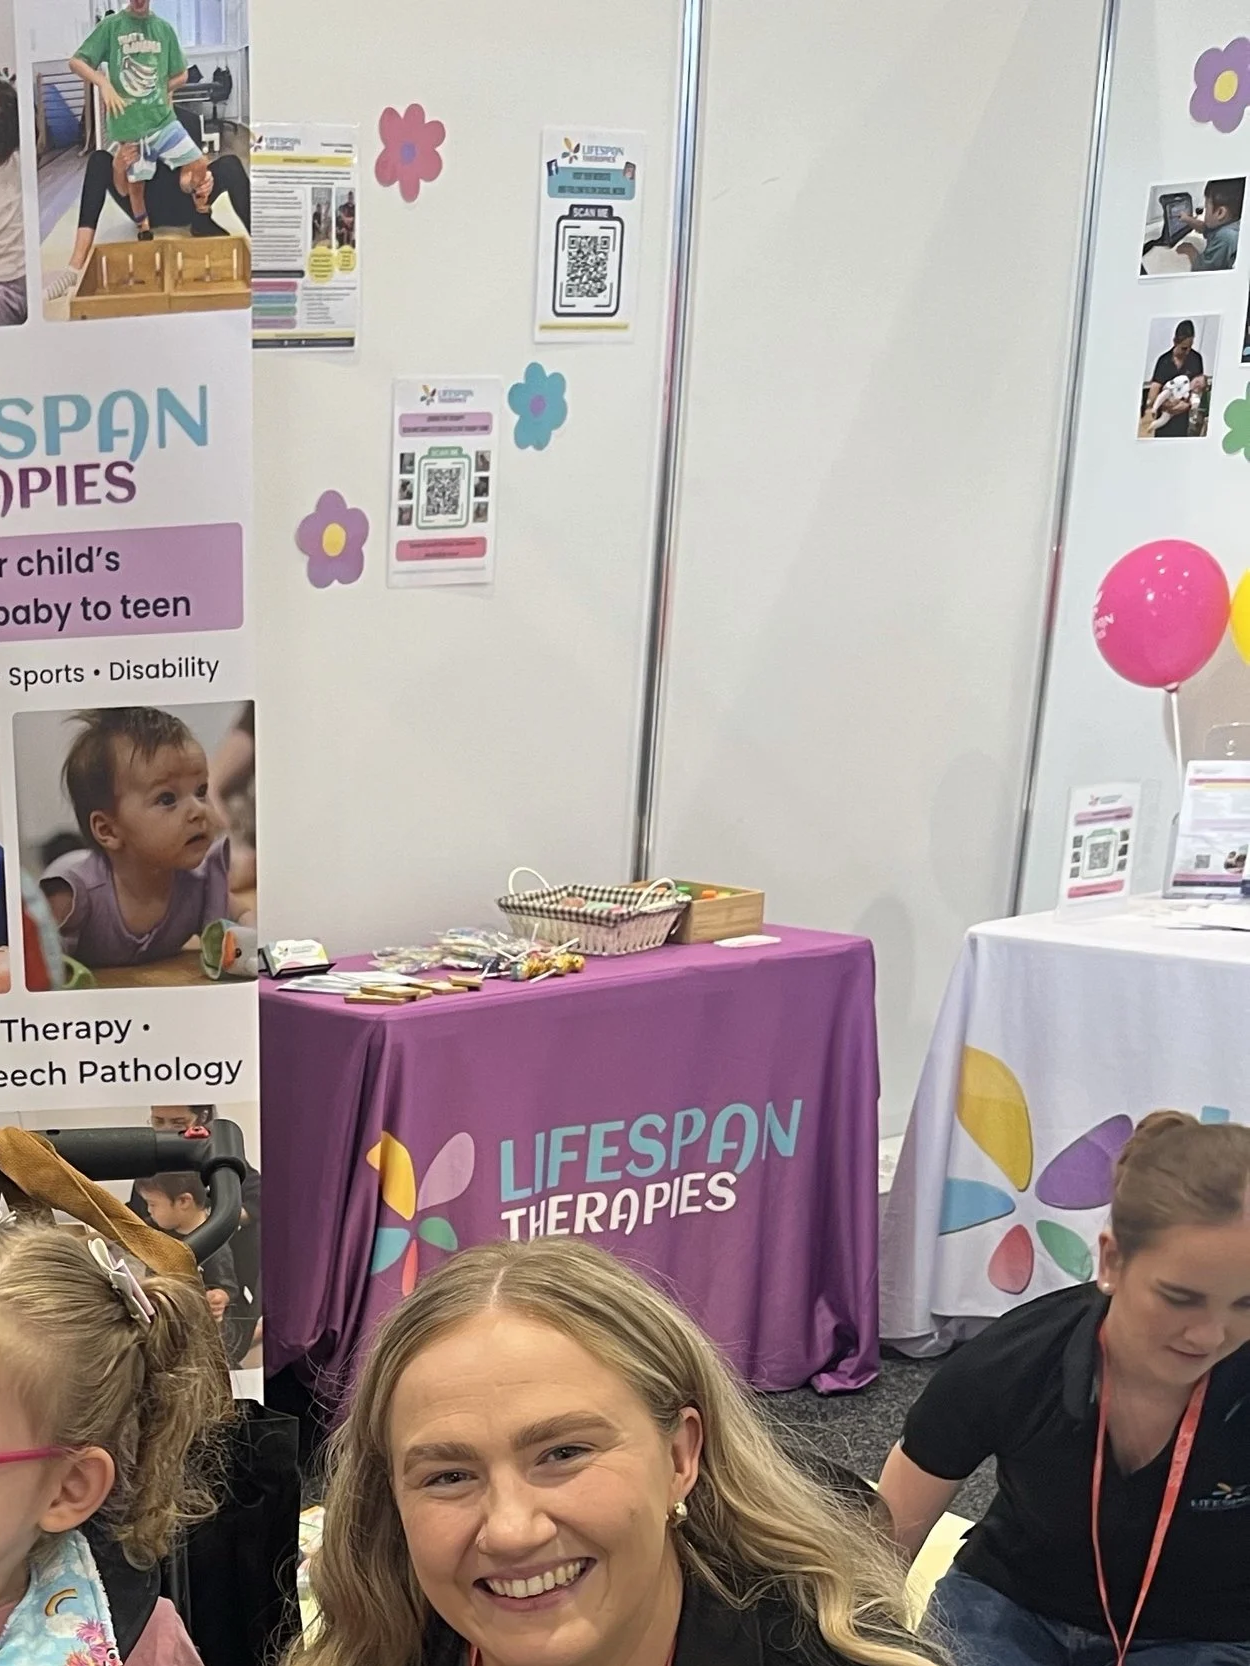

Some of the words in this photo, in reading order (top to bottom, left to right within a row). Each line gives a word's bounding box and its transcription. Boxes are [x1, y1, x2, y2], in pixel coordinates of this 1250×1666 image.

[573, 207, 597, 217] SCAN
[17, 545, 120, 578] child’s
[80, 597, 111, 621] to
[121, 592, 192, 619] teen
[9, 662, 84, 689] Sports
[109, 655, 219, 684] Disability
[1, 1017, 132, 1048] Therapy
[79, 1056, 243, 1085] Pathology
[500, 1100, 802, 1202] LIFESPAN
[501, 1171, 737, 1242] THERAPIES
